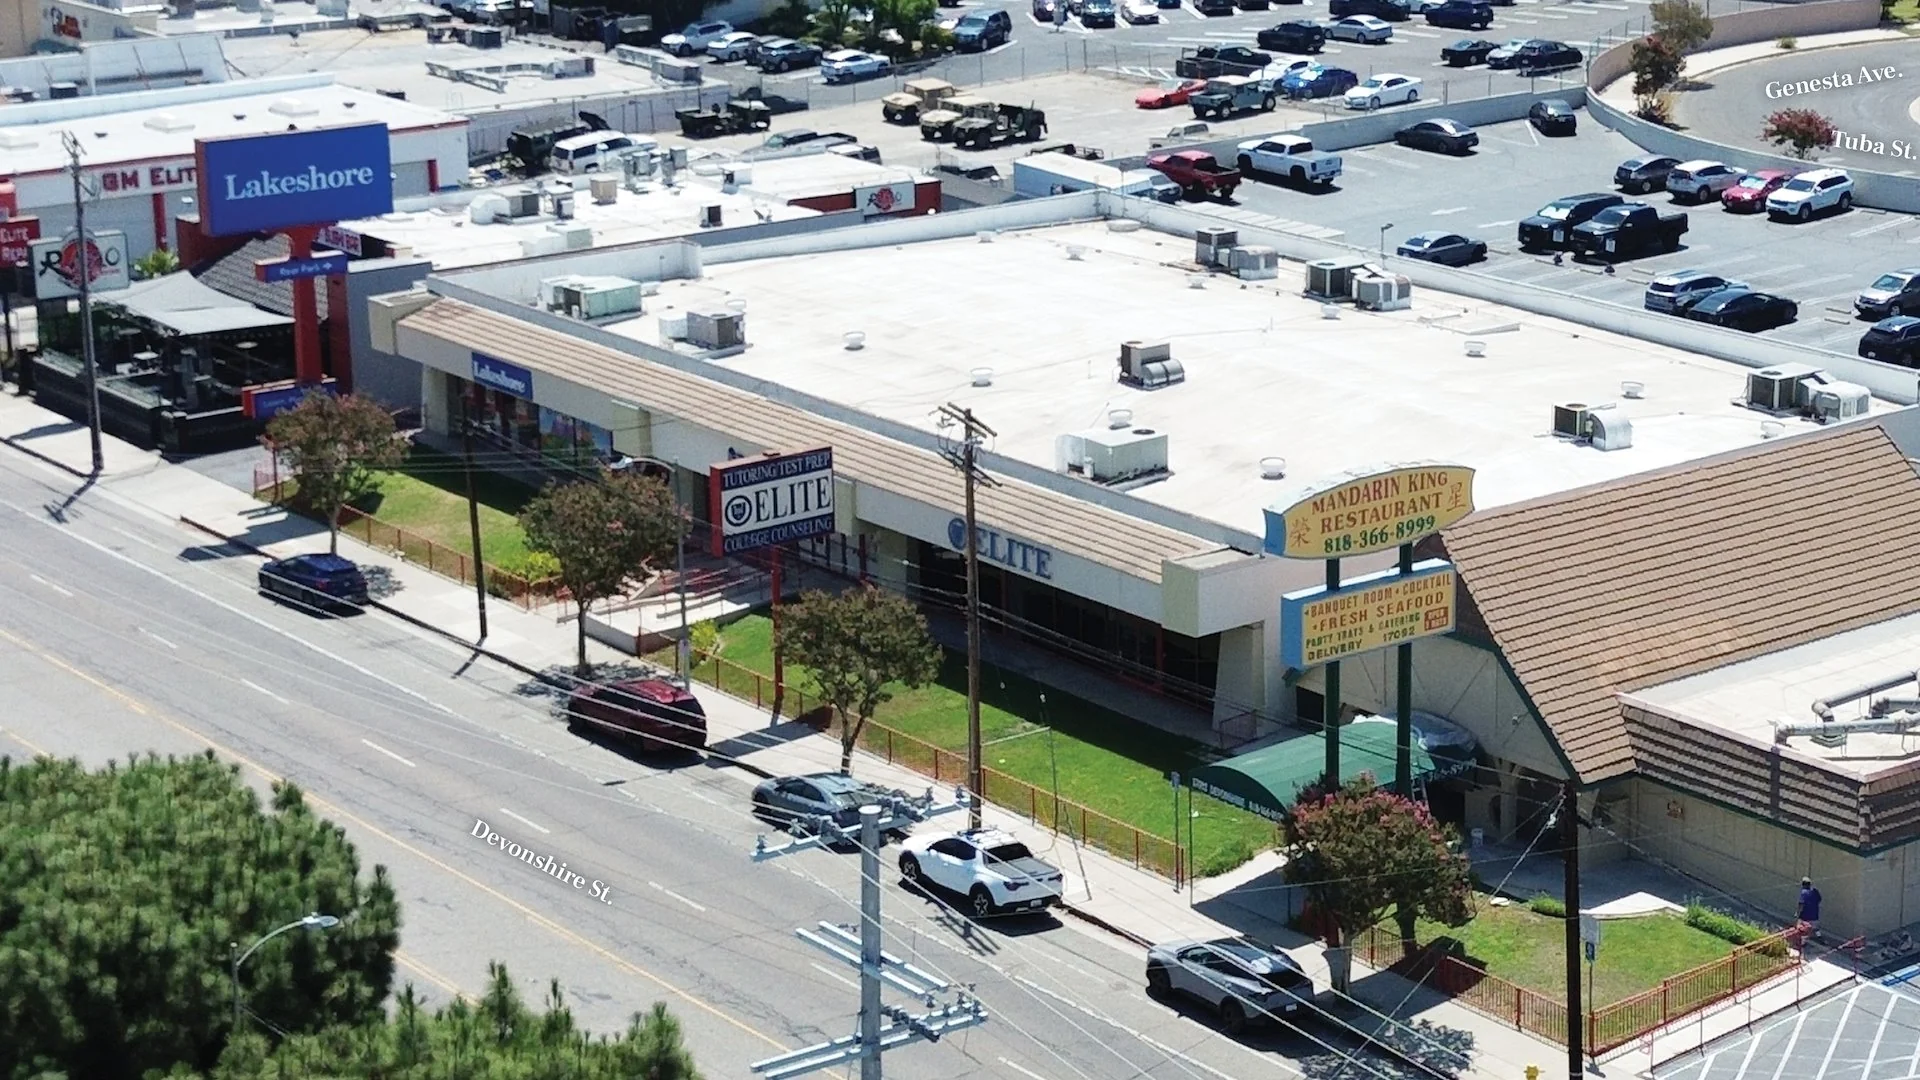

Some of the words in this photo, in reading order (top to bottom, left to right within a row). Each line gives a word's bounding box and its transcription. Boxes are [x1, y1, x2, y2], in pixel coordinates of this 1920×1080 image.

[102, 169, 139, 192] GM
[150, 166, 196, 187] ELIT
[224, 165, 374, 201] Lakeshore
[472, 361, 526, 394] Lakeshore
[723, 463, 777, 488] TUTORING
[779, 458, 805, 475] TEST
[805, 452, 830, 470] PREP
[755, 475, 832, 523] ELITE
[1312, 475, 1402, 516] MANDARIN
[1408, 471, 1448, 493] KING
[1320, 491, 1444, 535] RESTAURANT
[724, 530, 771, 552] COLLEGE
[771, 517, 833, 541] COUNSELING
[975, 526, 1052, 580] ELITE
[1323, 515, 1436, 554] 818-366-8999
[1310, 595, 1358, 618] BANQUET
[1363, 587, 1392, 605] ROOM
[1403, 573, 1452, 596] COCKTAIL
[1320, 609, 1368, 632] FRESH
[1376, 591, 1444, 618] SEAFOOD
[1378, 612, 1420, 630] CATERING
[1307, 639, 1362, 661] DELIVERY
[1382, 625, 1416, 642] 17092
